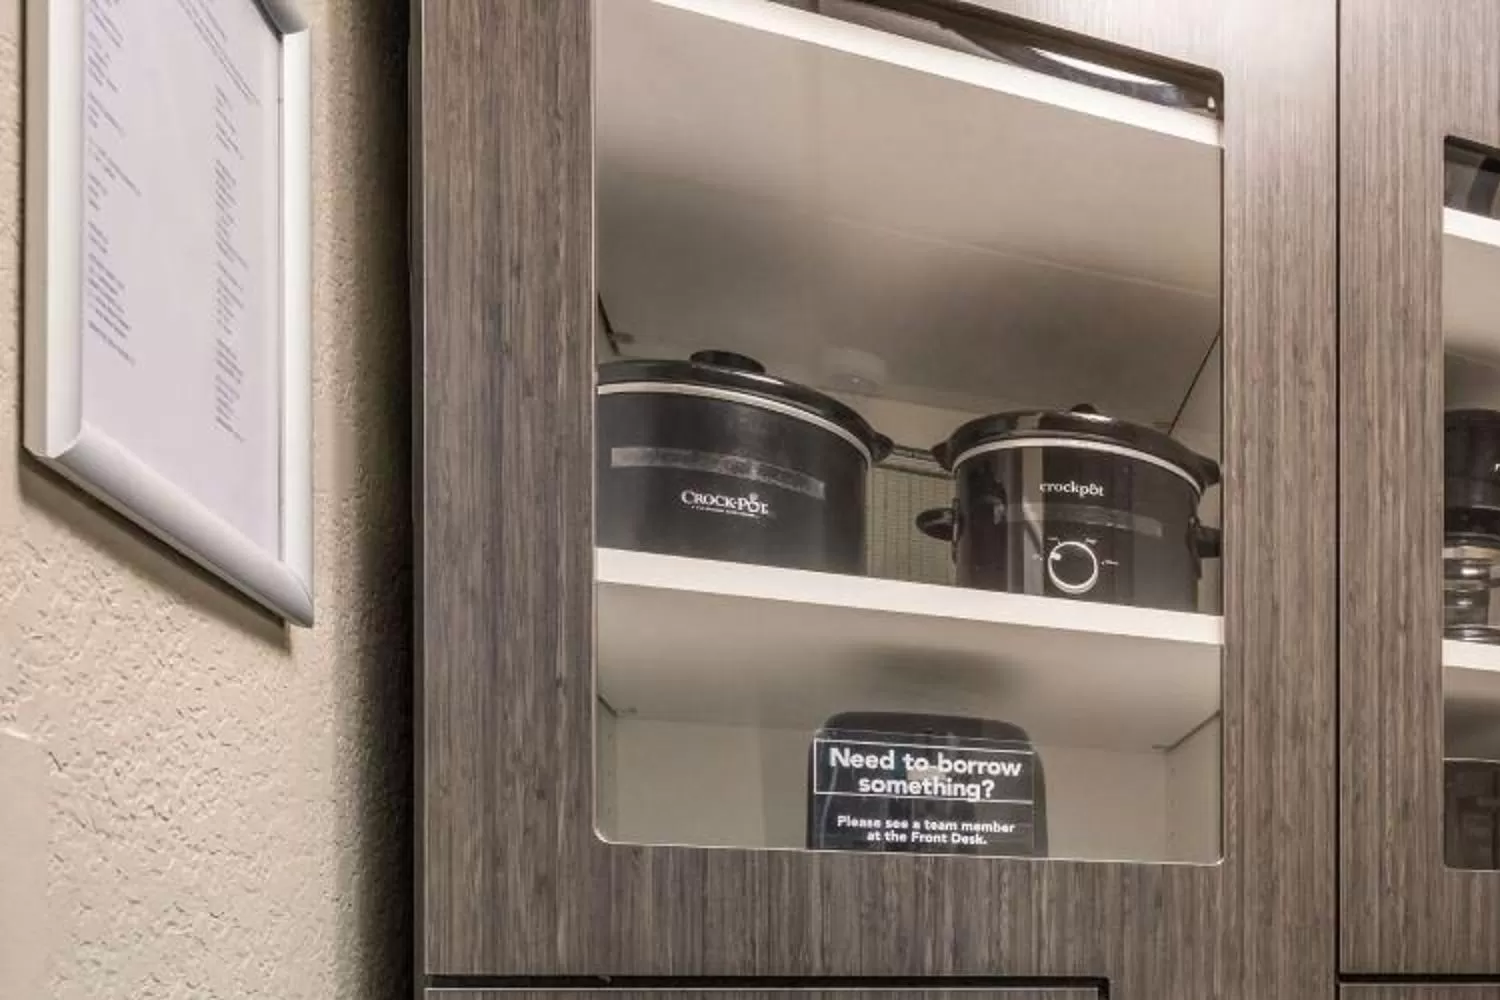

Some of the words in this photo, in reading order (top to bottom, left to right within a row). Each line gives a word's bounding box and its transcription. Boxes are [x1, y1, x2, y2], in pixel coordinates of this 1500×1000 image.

[829, 747, 894, 770] Need
[903, 753, 931, 772] to
[937, 752, 1022, 777] borrow
[858, 776, 995, 802] something?
[837, 815, 881, 828] Please
[885, 818, 908, 829] see
[912, 820, 920, 830] a
[924, 819, 957, 832] team
[961, 820, 1016, 834] member
[867, 830, 881, 842] at
[884, 831, 907, 842] the
[911, 832, 948, 844] Front
[951, 833, 988, 846] Desk.
